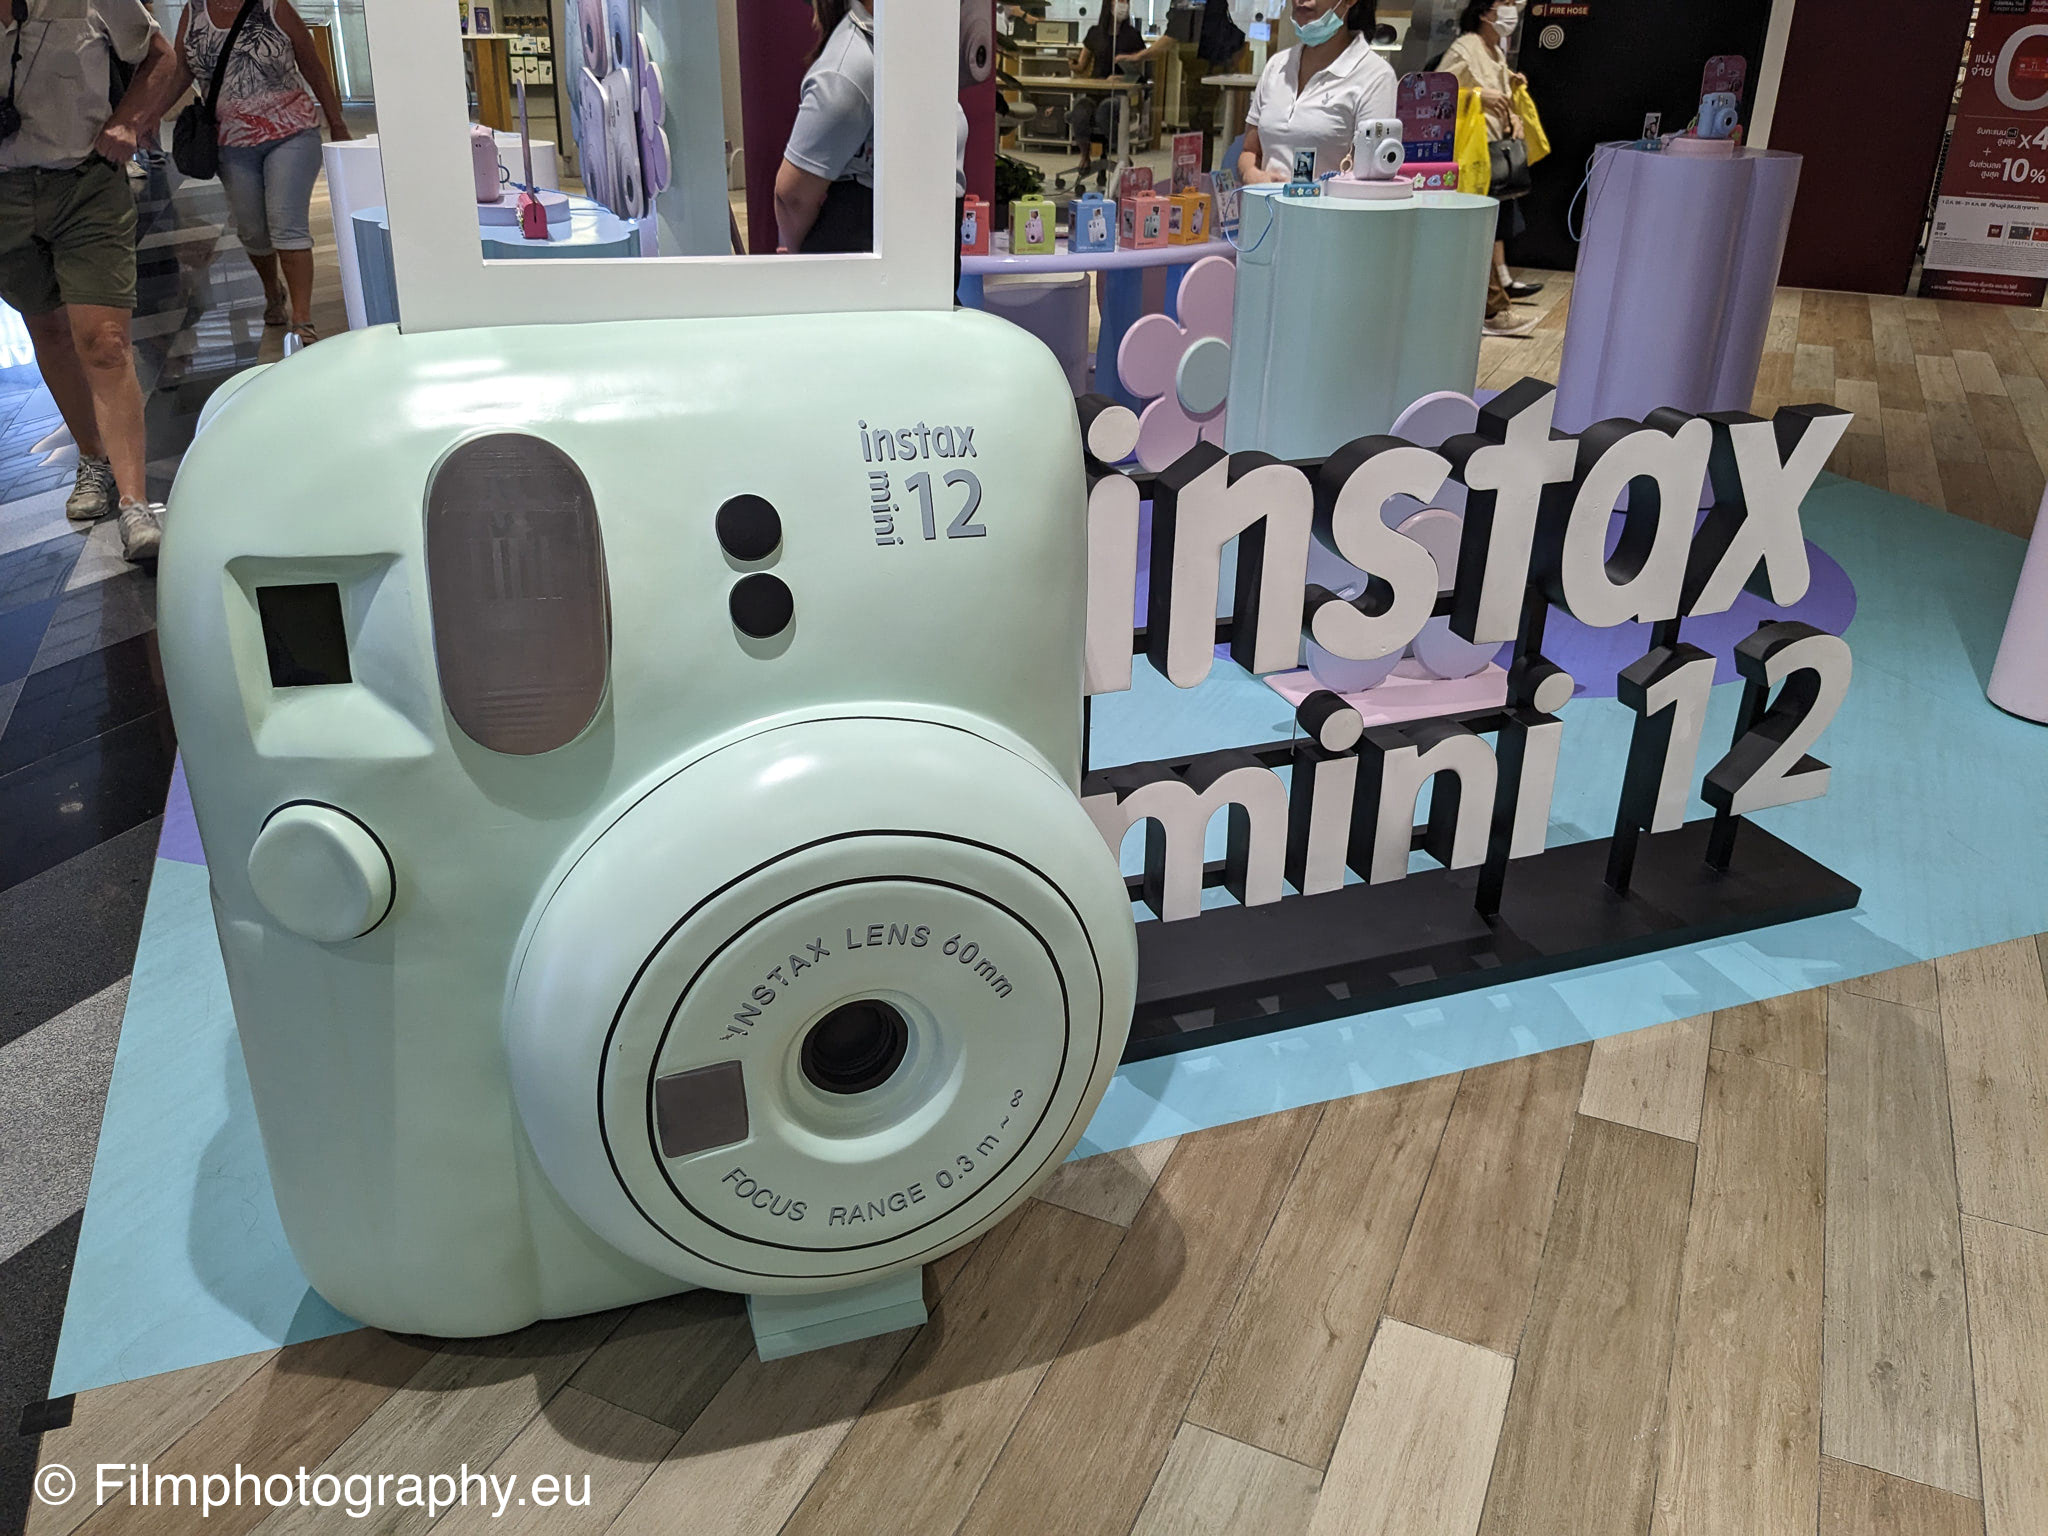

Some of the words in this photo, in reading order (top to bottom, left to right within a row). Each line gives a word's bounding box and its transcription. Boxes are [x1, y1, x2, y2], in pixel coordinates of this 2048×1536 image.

[1549, 6, 1566, 15] FIRE
[1566, 6, 1588, 15] HOSE
[857, 419, 978, 463] instax
[868, 470, 904, 546] mini
[904, 468, 987, 540] 12
[1084, 382, 1854, 694] instax
[1081, 674, 1576, 923] mini
[1634, 628, 1853, 834] 12
[728, 936, 831, 1036] INSTAX
[845, 922, 931, 950] LENS
[941, 934, 1014, 999] 60mm
[721, 1166, 808, 1222] FOCUS
[828, 1182, 927, 1227] RANGE
[935, 1154, 975, 1190] 0.3
[976, 1133, 1001, 1157] m
